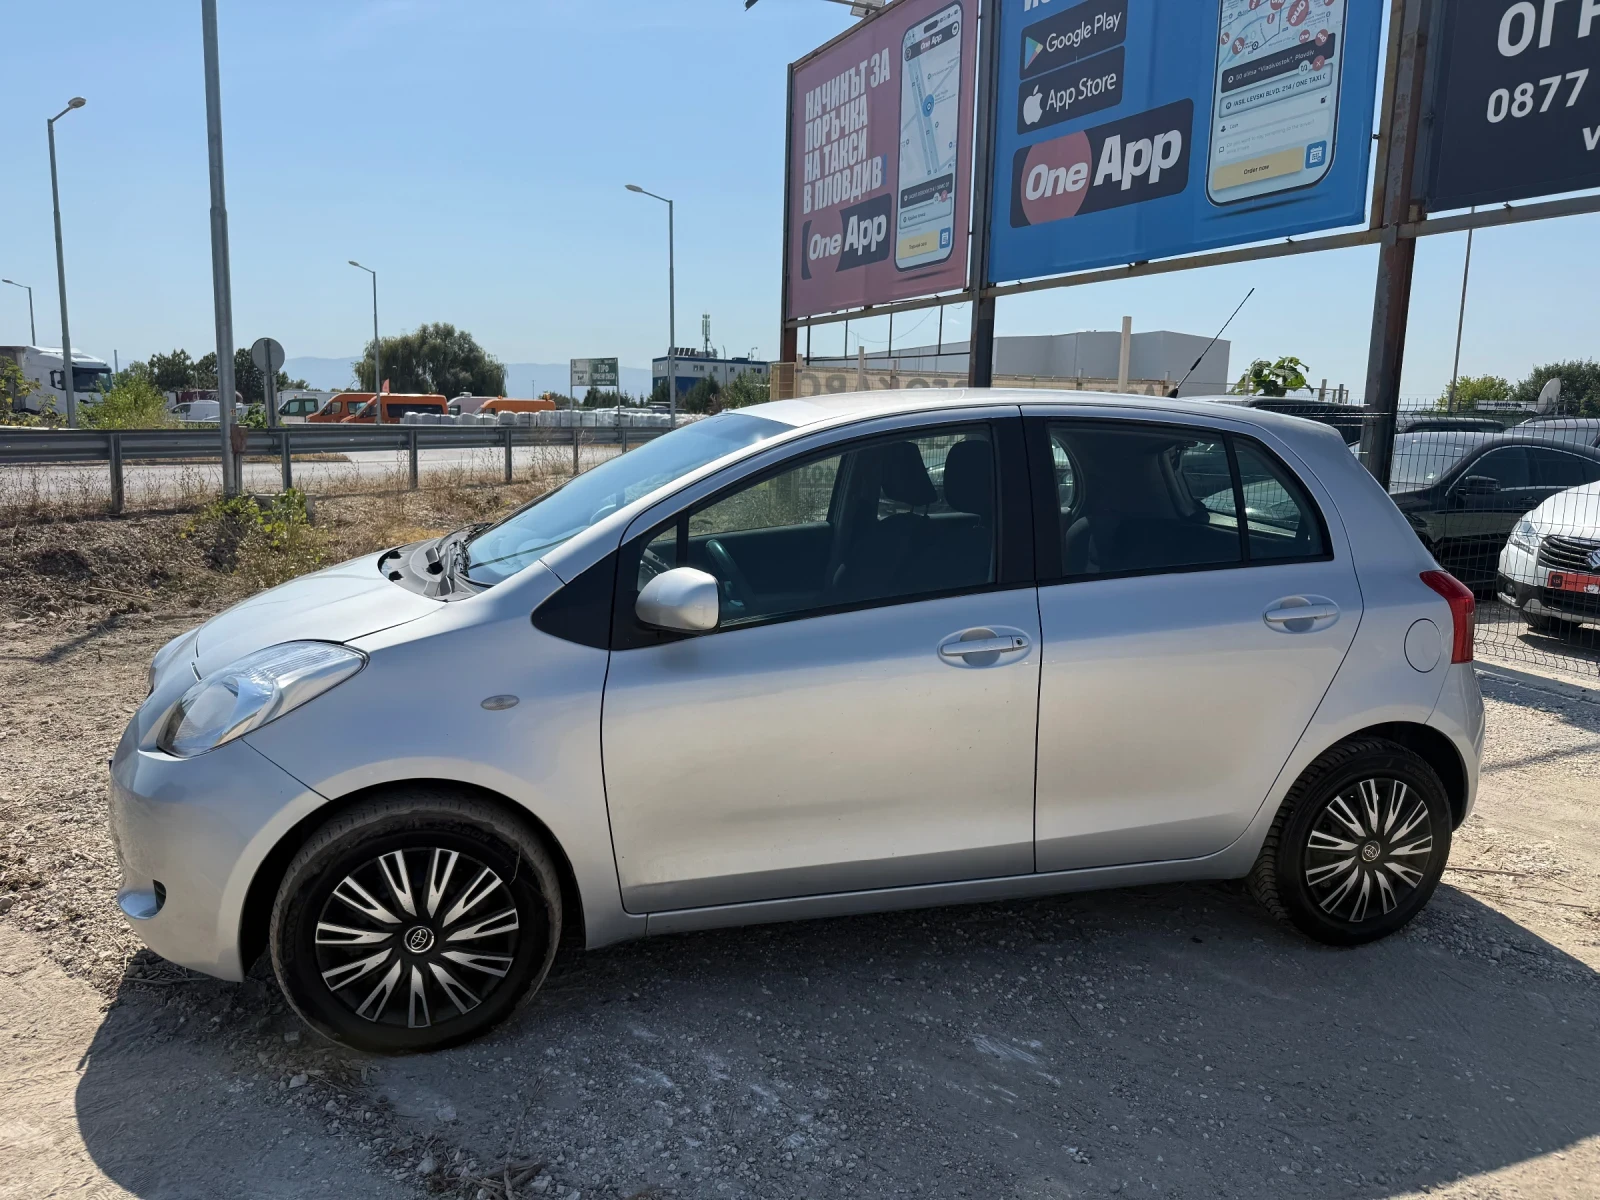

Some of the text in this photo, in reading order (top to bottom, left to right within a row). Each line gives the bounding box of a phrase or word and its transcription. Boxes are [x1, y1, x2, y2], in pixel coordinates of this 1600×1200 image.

[1046, 11, 1122, 53] Google Play
[805, 59, 868, 122] НАЧИНЪТ
[870, 47, 891, 88] ЗА
[1046, 72, 1117, 113] App Store
[1246, 92, 1265, 103] LEVSKI
[1296, 78, 1308, 88] ONE
[1309, 74, 1322, 84] TAXI
[1487, 68, 1589, 123] 0877
[804, 93, 868, 153] ПОРЪЧКА
[804, 127, 868, 183] НА ТАКСИ
[1025, 129, 1182, 200] One App
[1243, 166, 1258, 175] Order
[803, 183, 812, 215] В
[809, 213, 887, 261] One App
